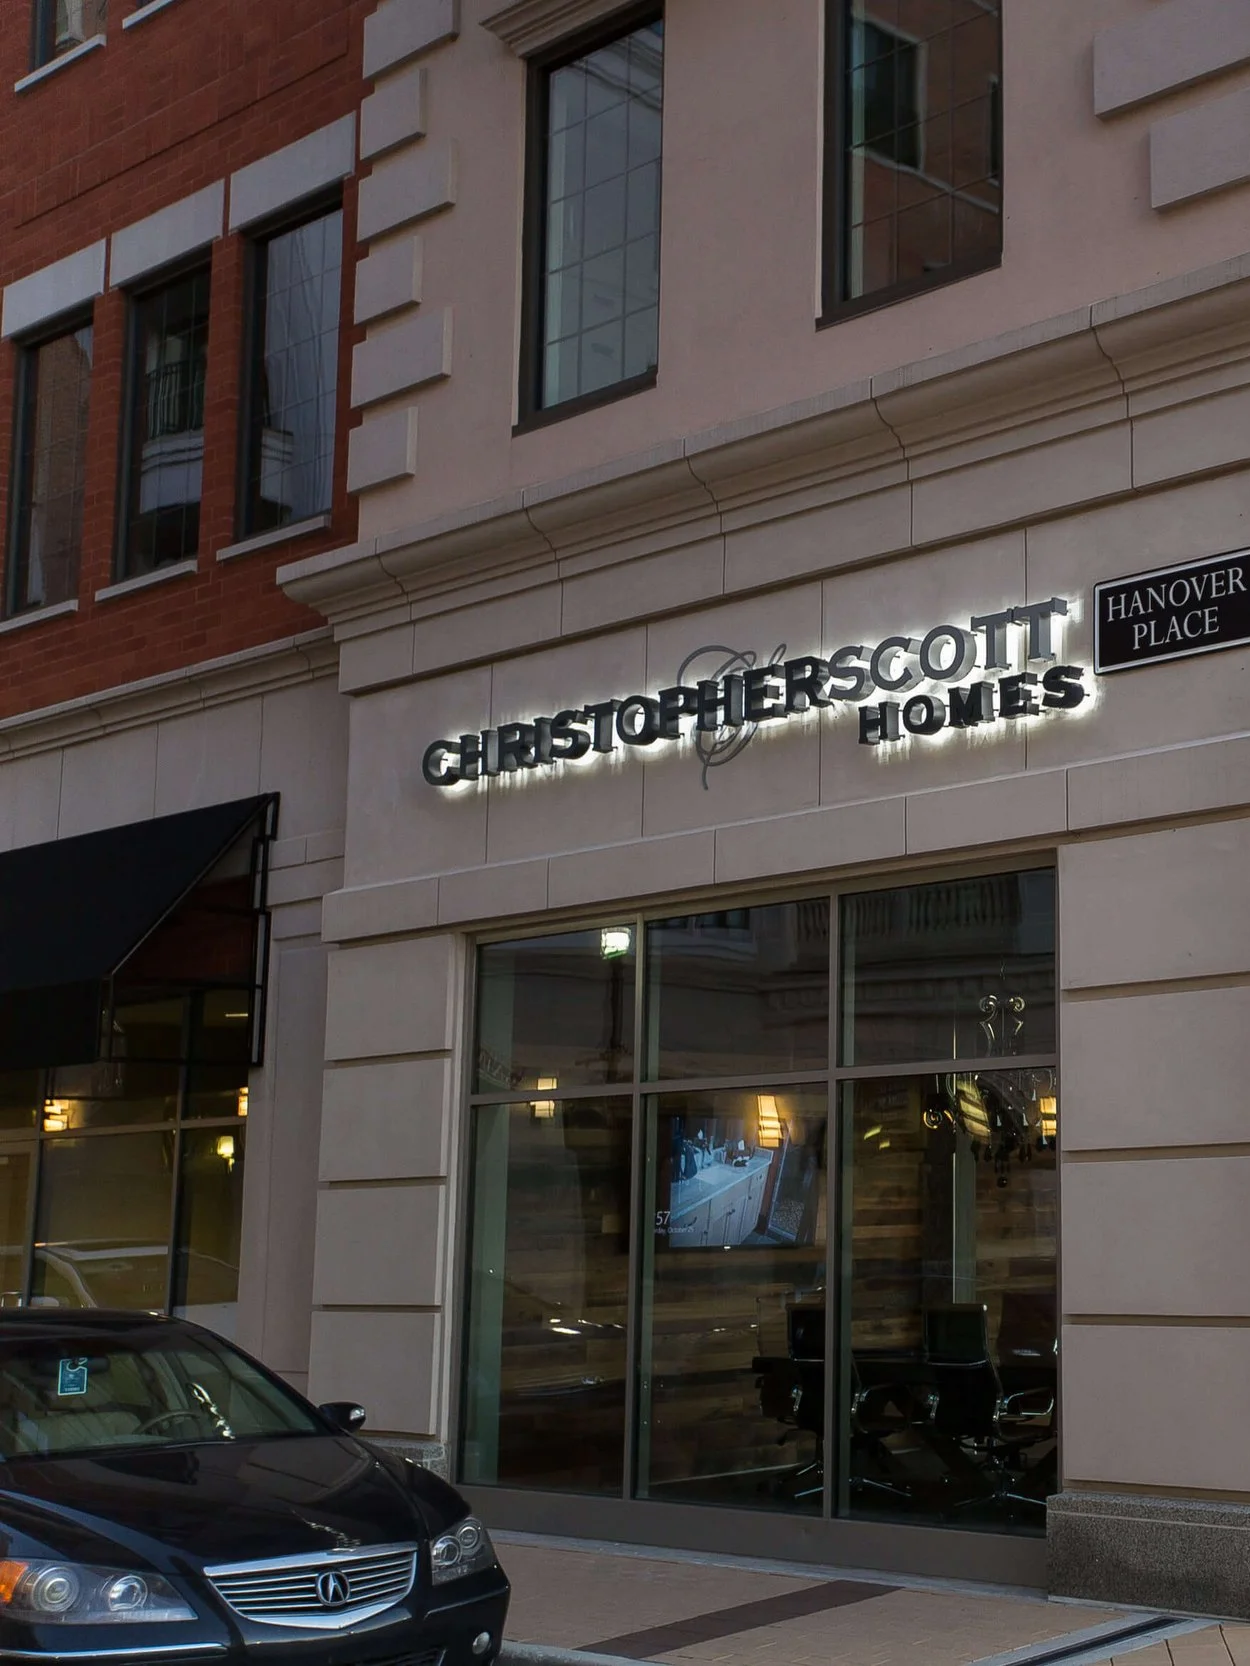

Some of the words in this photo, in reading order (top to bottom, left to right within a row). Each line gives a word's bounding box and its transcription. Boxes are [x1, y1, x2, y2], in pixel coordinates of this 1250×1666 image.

[1107, 566, 1247, 622] HANOVER
[1133, 607, 1219, 650] PLACE
[858, 664, 1091, 746] HOMES
